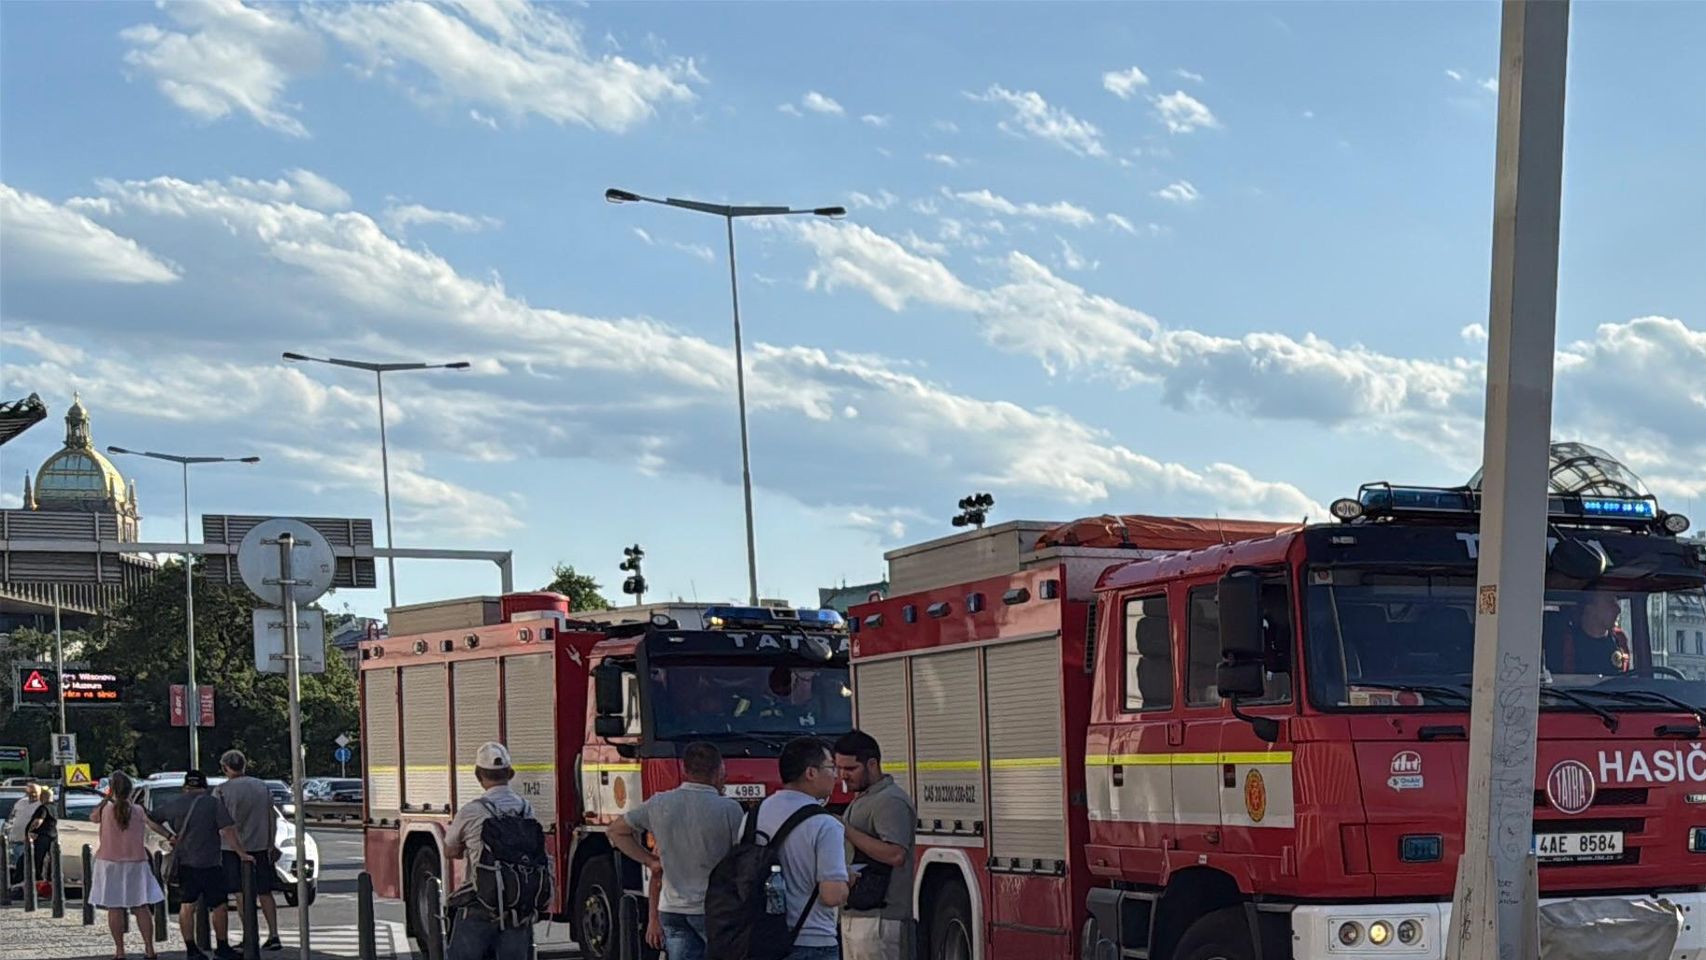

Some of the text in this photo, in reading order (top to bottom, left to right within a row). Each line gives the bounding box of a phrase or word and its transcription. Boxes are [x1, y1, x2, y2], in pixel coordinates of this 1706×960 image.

[735, 785, 762, 796] 4983
[1555, 766, 1586, 809] TATRA
[1540, 834, 1616, 853] 4AE 8584
